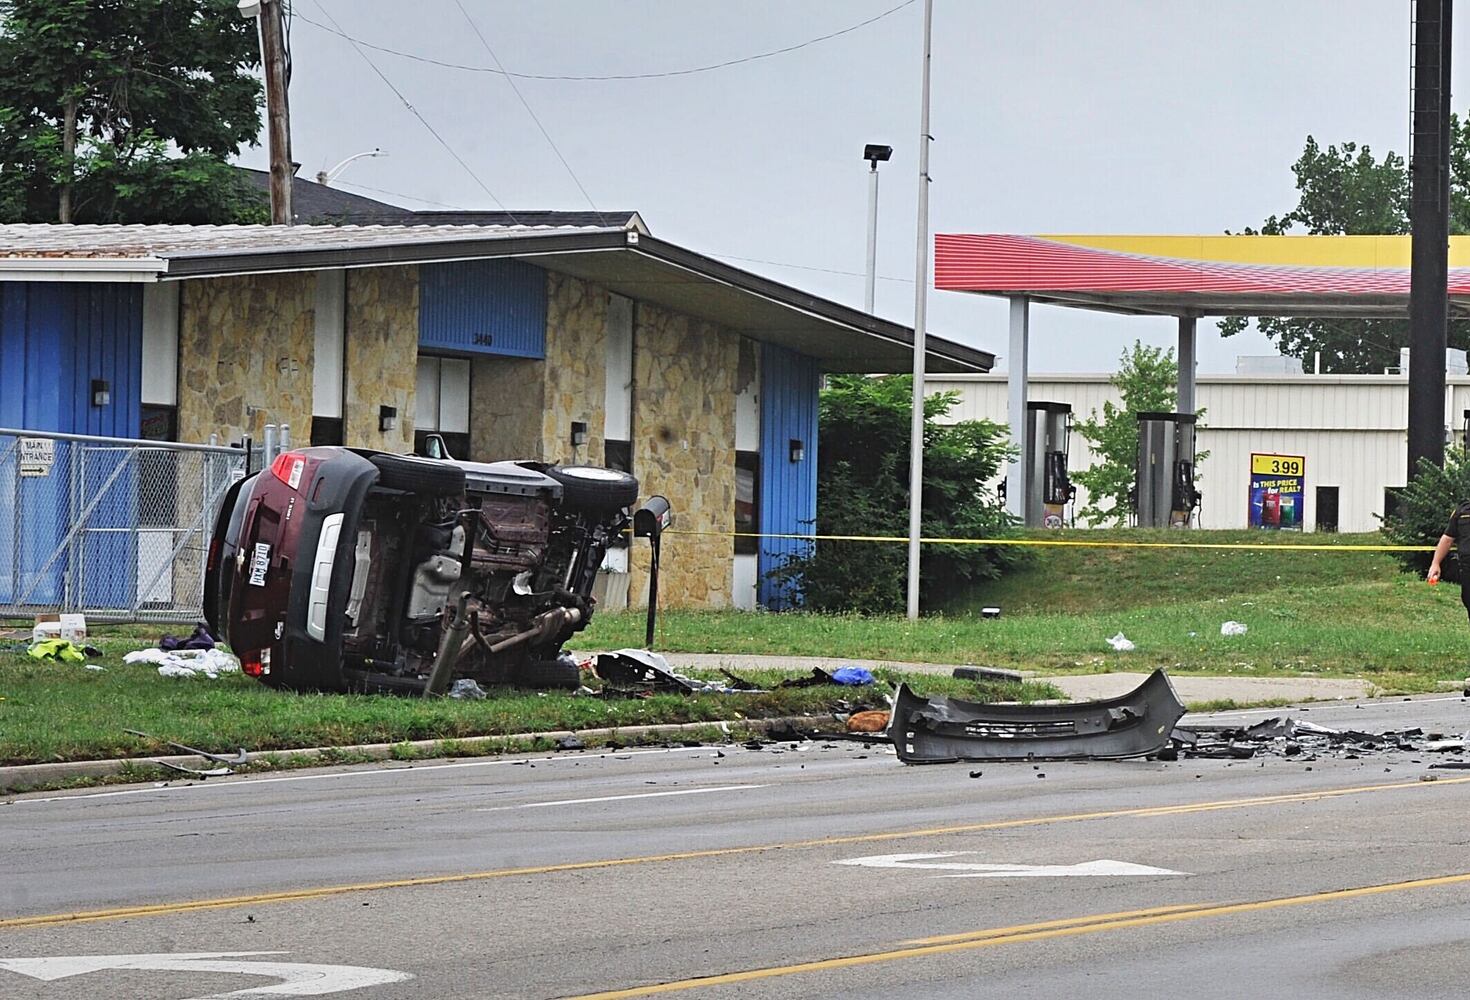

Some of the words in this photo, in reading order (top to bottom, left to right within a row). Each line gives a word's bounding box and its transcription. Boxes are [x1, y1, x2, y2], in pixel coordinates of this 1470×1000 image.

[1272, 460, 1299, 474] 3.99
[1260, 480, 1276, 488] THIS
[1277, 479, 1297, 487] PRICE
[1279, 486, 1301, 494] REAL?
